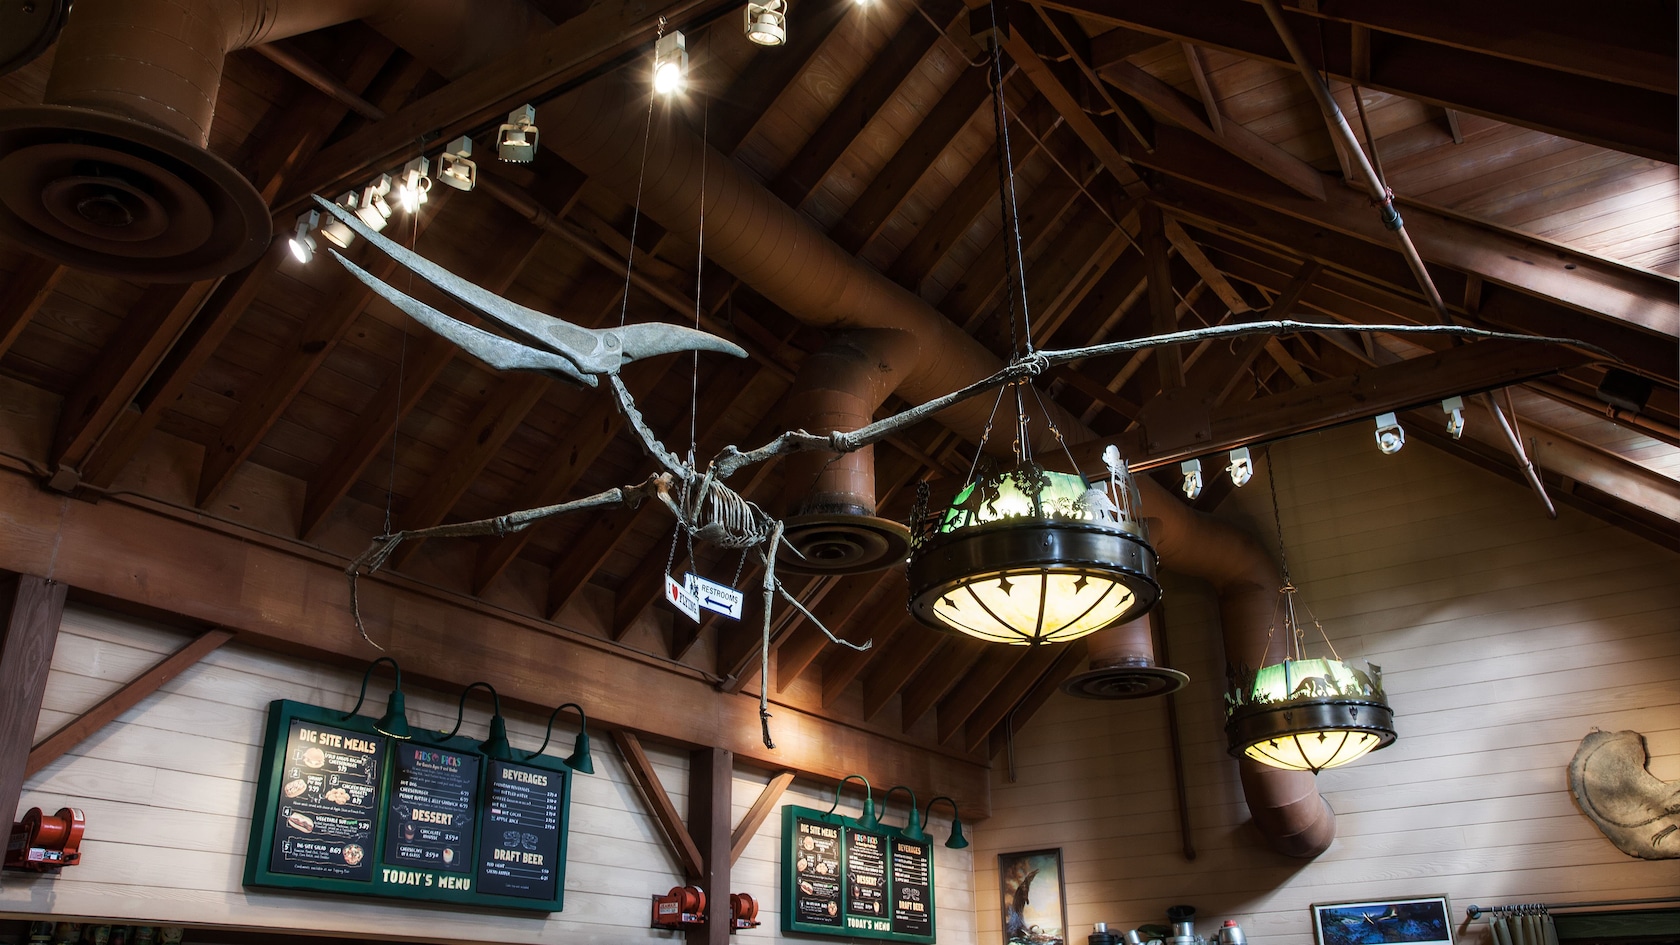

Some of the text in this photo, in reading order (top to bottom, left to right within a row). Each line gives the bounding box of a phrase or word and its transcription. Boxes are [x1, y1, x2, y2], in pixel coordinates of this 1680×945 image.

[668, 583, 697, 615] I FLYING
[701, 585, 738, 604] RESTROOMS
[299, 728, 376, 754] DIG SITE MEALS
[328, 759, 358, 768] CHEESEBURGER
[502, 768, 547, 787] BEVERAGES
[399, 787, 429, 796] CHEESEBURGER
[413, 795, 428, 803] BUTTER
[316, 816, 338, 824] VEGETABLE
[412, 809, 453, 826] DESSERT
[420, 829, 441, 837] CHOCOLATE
[800, 823, 838, 839] DIG SITE MEALS
[493, 848, 544, 866] DRAFT BEER
[897, 843, 922, 856] BEVERAGES
[382, 868, 471, 891] TODAY'S MENU
[856, 874, 877, 887] DESSERT
[898, 900, 925, 912] DRAFT BEER
[847, 917, 873, 930] TODAY'S
[873, 920, 892, 932] MENU
